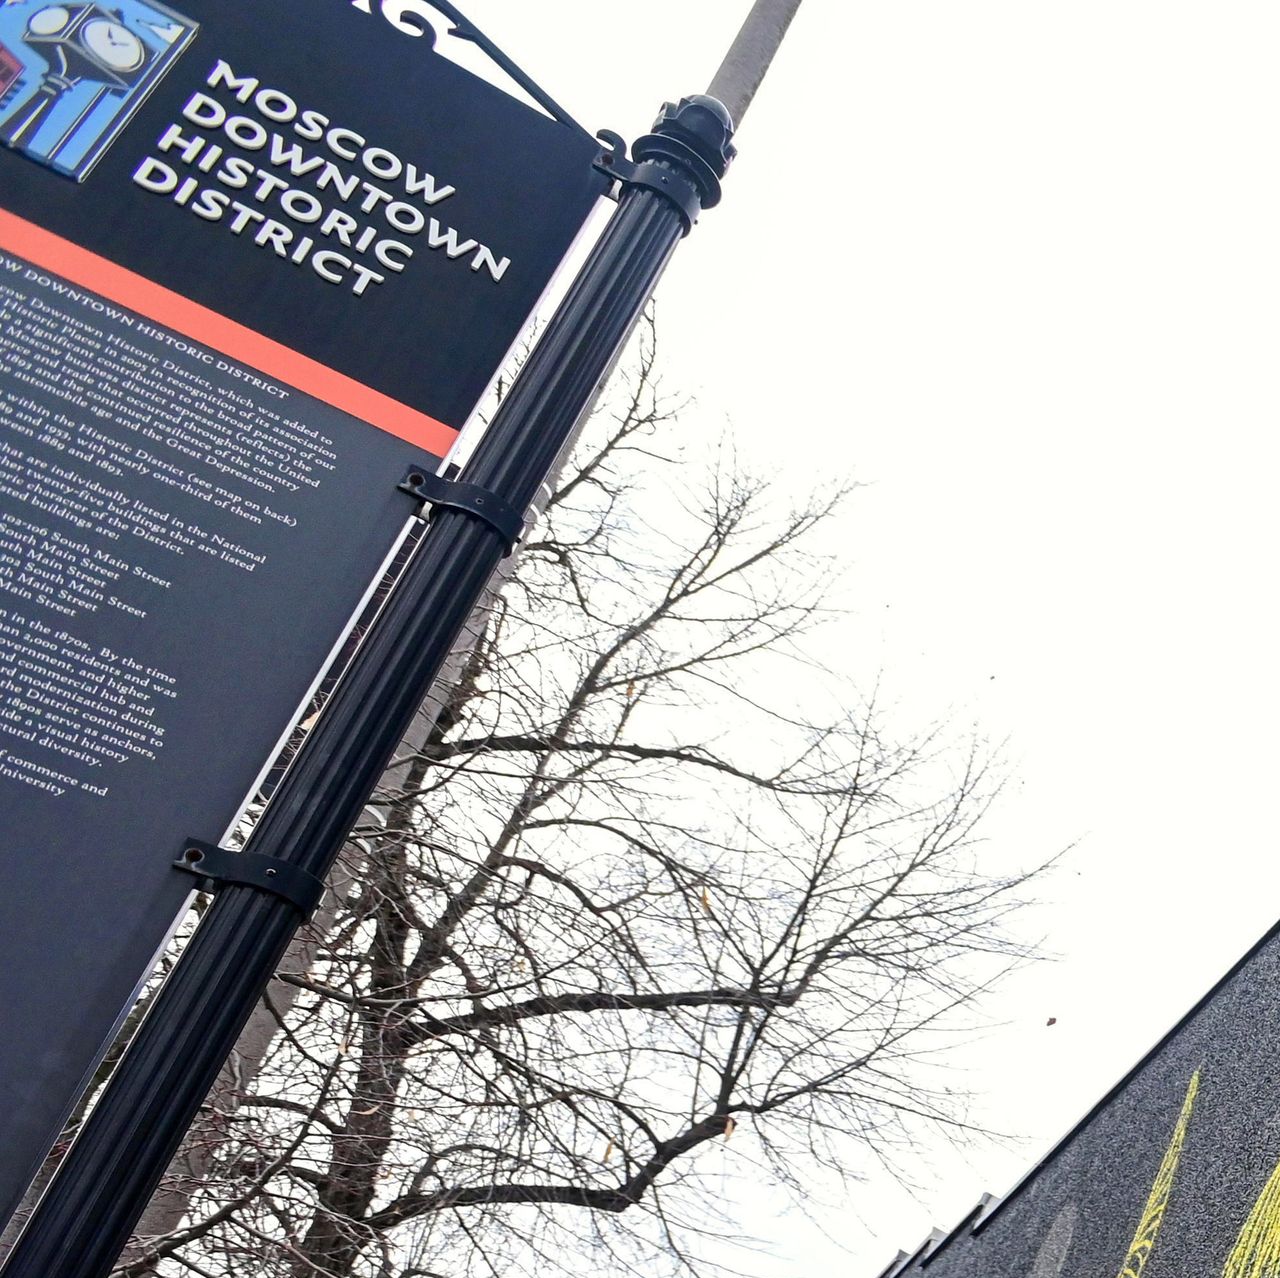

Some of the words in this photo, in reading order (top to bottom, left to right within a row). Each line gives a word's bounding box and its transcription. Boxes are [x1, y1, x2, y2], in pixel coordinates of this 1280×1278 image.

[207, 59, 456, 205] MOSCOW
[158, 124, 414, 273] HISTORIC
[182, 92, 511, 283] DOWNTOWN
[133, 156, 384, 296] DISTRICT
[24, 269, 135, 326] DOWNTOWN
[136, 323, 214, 364] HISTORIC
[216, 360, 290, 399] DISTRICT
[4, 298, 58, 328] Historic
[61, 325, 101, 349] Places
[104, 346, 117, 357] in
[121, 355, 148, 371] 2005
[150, 367, 163, 378] in
[167, 377, 236, 413] recognition
[239, 411, 255, 419] of
[255, 416, 270, 428] its
[272, 427, 337, 460] association
[6, 326, 62, 356] Moscow
[65, 352, 119, 383] business
[122, 380, 167, 405] district
[170, 403, 232, 435] represents
[236, 432, 290, 462] (reflects)
[293, 460, 312, 472] the
[25, 324, 94, 358] significant
[97, 357, 175, 397] contribution
[179, 394, 192, 403] to
[195, 401, 214, 414] the
[217, 410, 253, 432] broad
[253, 430, 297, 453] pattern
[299, 452, 316, 460] of
[315, 459, 336, 470] our
[30, 297, 103, 338] Downtown
[107, 334, 159, 363] Historic
[162, 360, 212, 390] District,
[218, 387, 254, 408] which
[258, 406, 280, 421] was
[283, 419, 319, 438] added
[320, 436, 333, 445] to
[14, 371, 88, 407] automobile
[90, 406, 113, 418] age
[115, 417, 141, 431] and
[142, 428, 163, 441] the
[166, 438, 202, 459] Great
[205, 455, 275, 493] Depression.
[33, 354, 60, 368] and
[60, 365, 94, 384] trade
[98, 382, 123, 398] that
[126, 396, 182, 424] occurred
[184, 422, 252, 457] throughout
[255, 454, 274, 467] the
[278, 463, 321, 488] United
[35, 368, 61, 382] and
[63, 379, 84, 392] the
[86, 391, 152, 423] continued
[153, 421, 212, 450] resilience
[214, 449, 231, 458] of
[230, 456, 250, 468] the
[253, 467, 300, 491] country
[37, 434, 65, 450] 1889
[68, 448, 94, 462] and
[96, 460, 124, 476] 1893.
[7, 393, 50, 417] within
[54, 414, 75, 427] the
[78, 424, 132, 453] Historic
[135, 449, 184, 477] District
[187, 473, 212, 489] (see
[215, 487, 242, 503] map
[244, 501, 260, 511] on
[263, 506, 297, 527] back)
[16, 412, 43, 426] and
[77, 438, 106, 455] with
[109, 453, 150, 474] nearly
[153, 472, 213, 502] one-third
[214, 500, 231, 508] of
[230, 506, 262, 524] them
[26, 456, 48, 468] are
[51, 465, 130, 505] individually
[133, 500, 170, 521] listed
[171, 517, 184, 529] in
[187, 526, 208, 538] the
[211, 534, 267, 564] National
[27, 483, 88, 513] character
[91, 511, 108, 520] of
[108, 517, 129, 530] the
[132, 526, 184, 555] District.
[27, 469, 104, 506] twenty-five
[107, 502, 166, 533] buildings
[170, 531, 195, 546] that
[198, 544, 218, 555] are
[220, 551, 256, 572] listed
[31, 495, 92, 528] buildings
[0, 523, 36, 546] South
[40, 541, 76, 562] Main
[80, 558, 120, 580] Street
[27, 549, 63, 570] Main
[66, 566, 106, 588] Street
[51, 532, 90, 554] South
[94, 550, 129, 571] Main
[132, 566, 172, 588] Street
[0, 577, 32, 599] Main
[36, 594, 76, 616] Street
[17, 573, 54, 594] Main
[58, 589, 98, 612] Street
[24, 562, 64, 585] South
[68, 580, 104, 601] Main
[107, 596, 147, 618] Street
[11, 612, 25, 625] in
[29, 620, 51, 634] the
[54, 631, 91, 651] 1870s.
[100, 647, 119, 662] By
[122, 657, 143, 670] the
[146, 668, 176, 684] time
[23, 633, 58, 651] 2,000
[61, 648, 121, 676] residents
[124, 674, 150, 687] and
[153, 684, 177, 698] was
[0, 680, 22, 693] the
[26, 688, 79, 715] District
[82, 713, 146, 741] continues
[150, 738, 163, 747] to
[18, 660, 98, 694] commercial
[100, 689, 126, 705] hub
[129, 703, 155, 716] and
[19, 674, 117, 716] modernization
[121, 712, 165, 736] during
[79, 670, 106, 683] and
[107, 677, 151, 701] higher
[7, 697, 42, 715] 1890s
[45, 712, 81, 730] serve
[84, 727, 98, 736] as
[101, 734, 156, 760] anchors,
[38, 723, 79, 743] visual
[80, 737, 129, 762] history
[38, 737, 102, 767] diversity.
[7, 756, 78, 786] commerce
[81, 783, 108, 797] and
